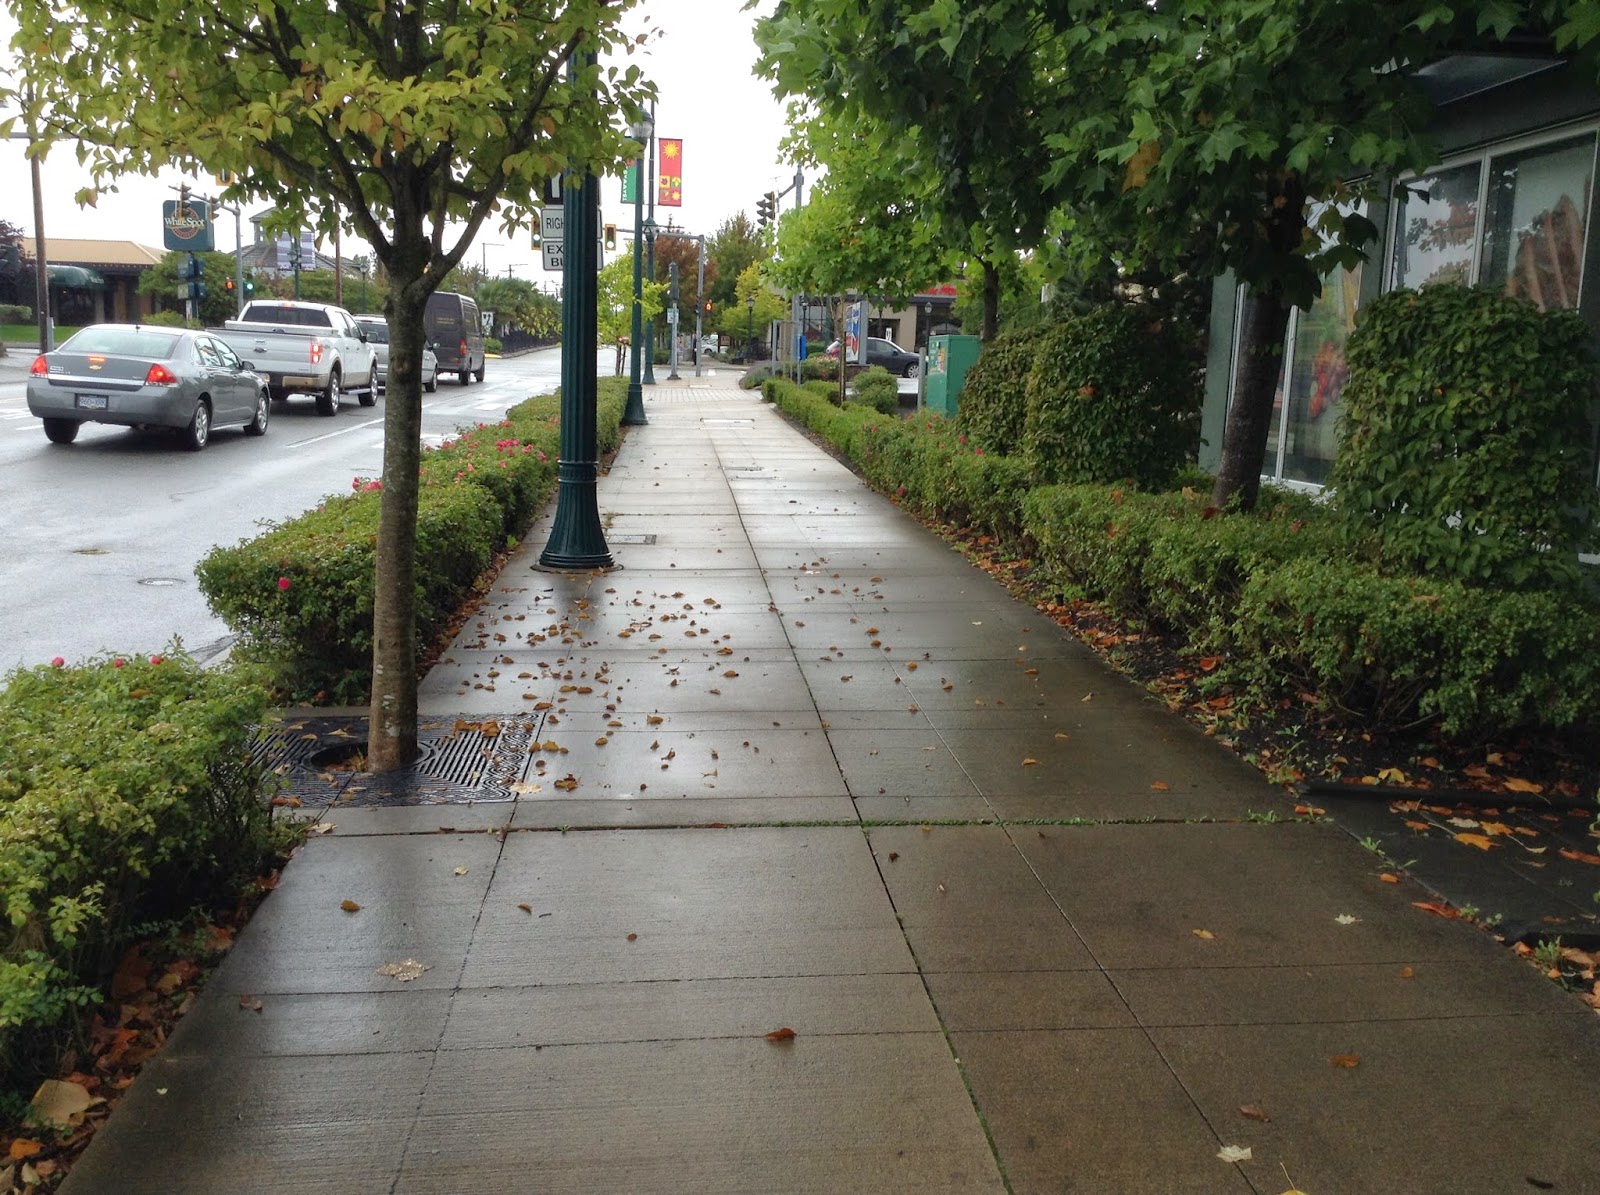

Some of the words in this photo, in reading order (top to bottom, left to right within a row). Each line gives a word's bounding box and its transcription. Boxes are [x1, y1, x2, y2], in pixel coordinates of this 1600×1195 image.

[164, 216, 187, 226] White
[186, 217, 205, 228] Spot
[546, 218, 564, 229] RIGH
